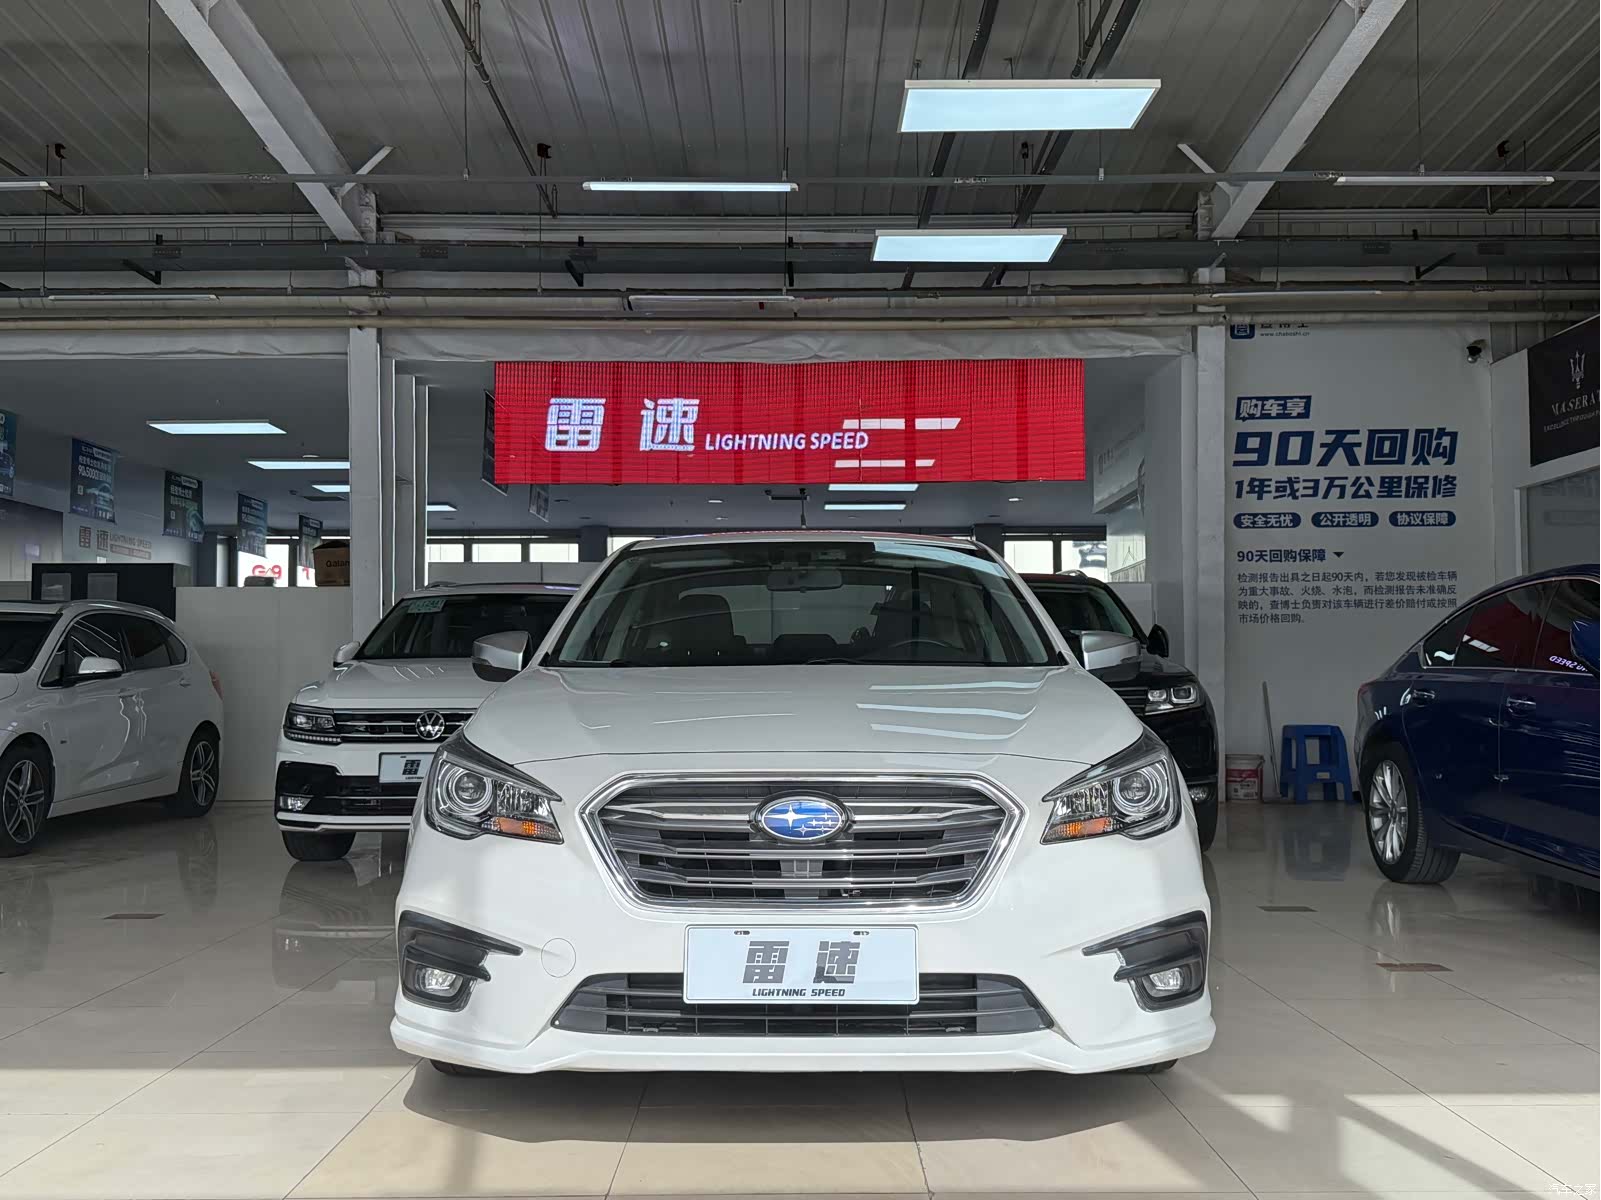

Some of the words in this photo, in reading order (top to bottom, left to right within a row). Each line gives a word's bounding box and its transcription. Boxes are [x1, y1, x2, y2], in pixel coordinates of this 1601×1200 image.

[1239, 398, 1307, 418] 购车享
[705, 432, 806, 451] LIGHTNING
[810, 431, 869, 450] SPEED
[1232, 427, 1459, 467] 90天回购
[1234, 474, 1458, 501] 1年或3万公里保修
[1240, 513, 1294, 528] 安全无忧
[1319, 512, 1372, 527] 公开透明
[1397, 511, 1450, 527] 协议保障
[1236, 549, 1327, 563] 90天回购保障
[752, 988, 806, 997] LIGHTNING
[811, 988, 846, 997] SPEED
